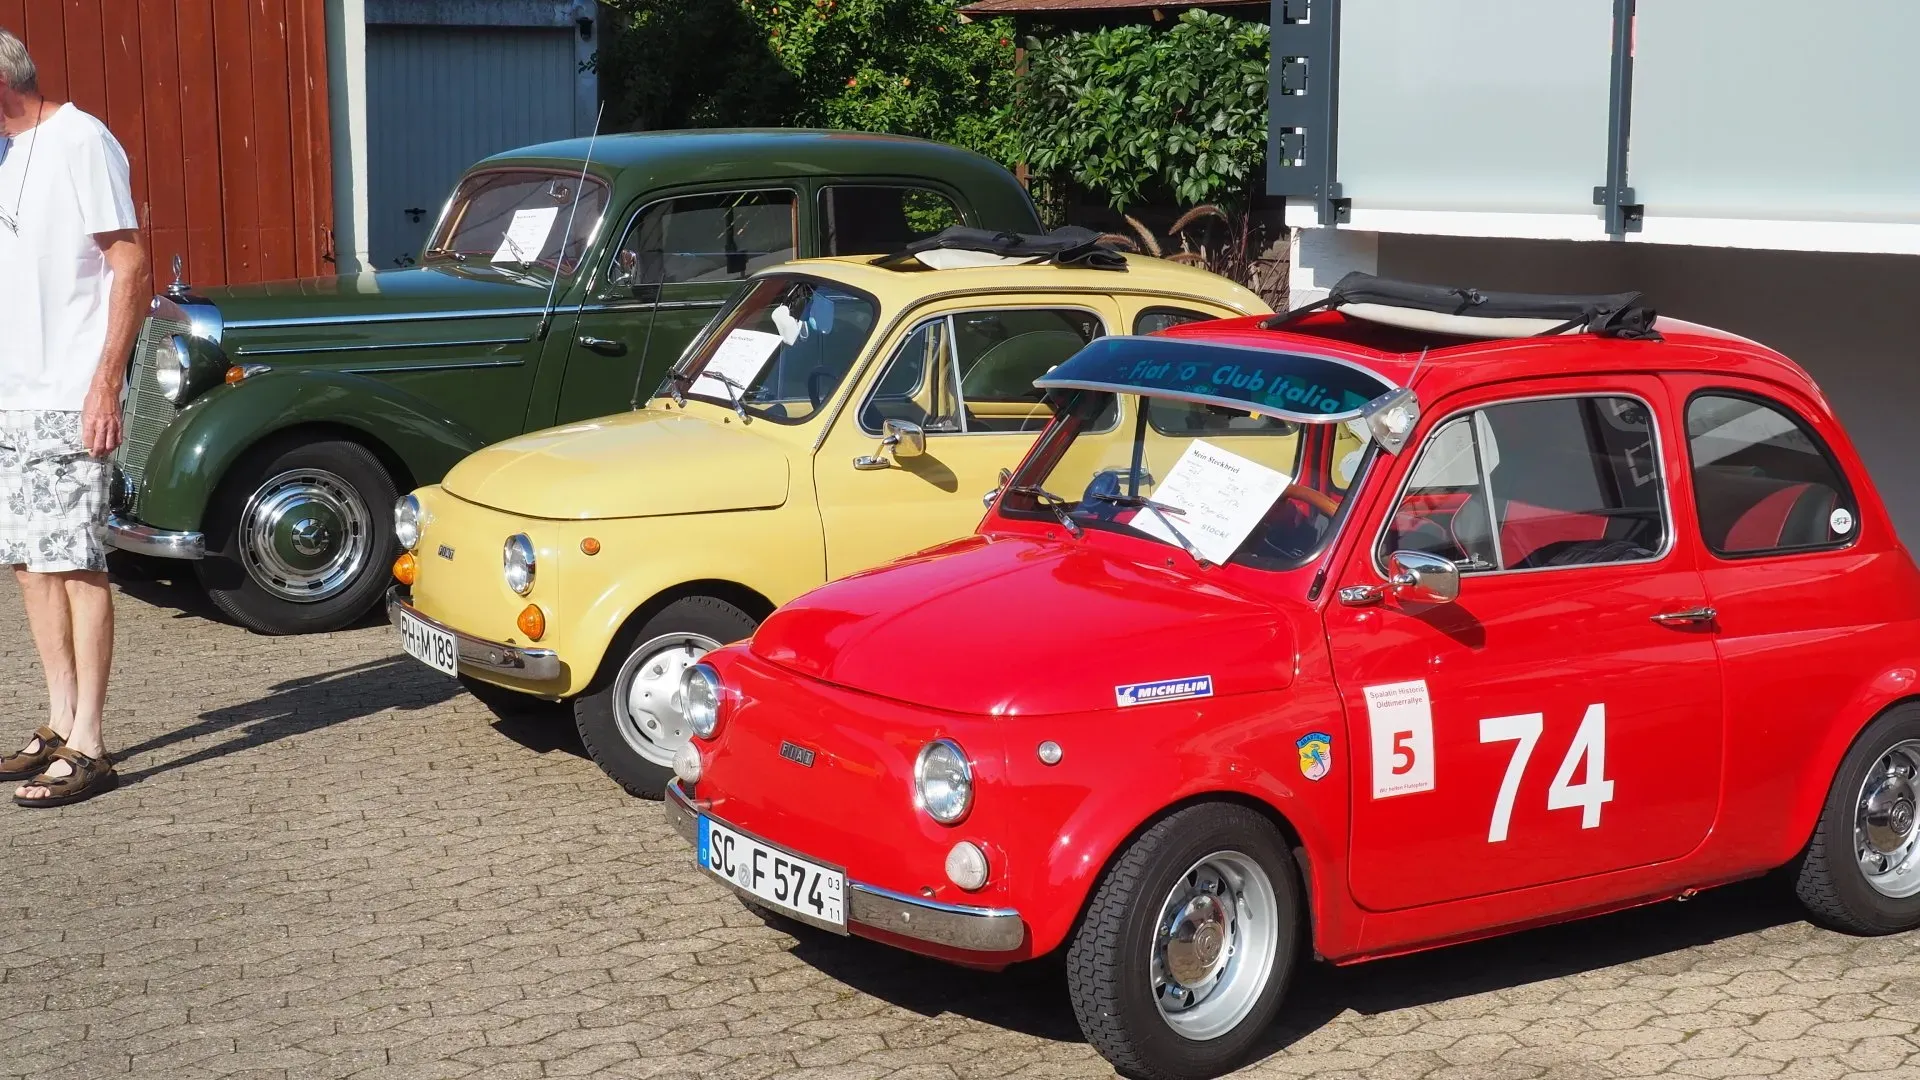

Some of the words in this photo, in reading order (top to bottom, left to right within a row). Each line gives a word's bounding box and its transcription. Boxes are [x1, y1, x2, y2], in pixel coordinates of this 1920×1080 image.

[1128, 359, 1171, 380] Fiat
[1212, 364, 1265, 391] Club
[1269, 376, 1341, 413] Italia
[1207, 456, 1241, 474] Steckbrief
[1137, 681, 1208, 698] MICHELIN
[781, 743, 813, 765] FIAT
[1392, 730, 1415, 775] 5
[1479, 703, 1614, 843] 74
[702, 848, 707, 860] D
[711, 829, 735, 878] SC
[752, 848, 767, 890] F
[774, 857, 824, 915] 574
[828, 877, 840, 891] 03
[829, 908, 840, 921] 11
